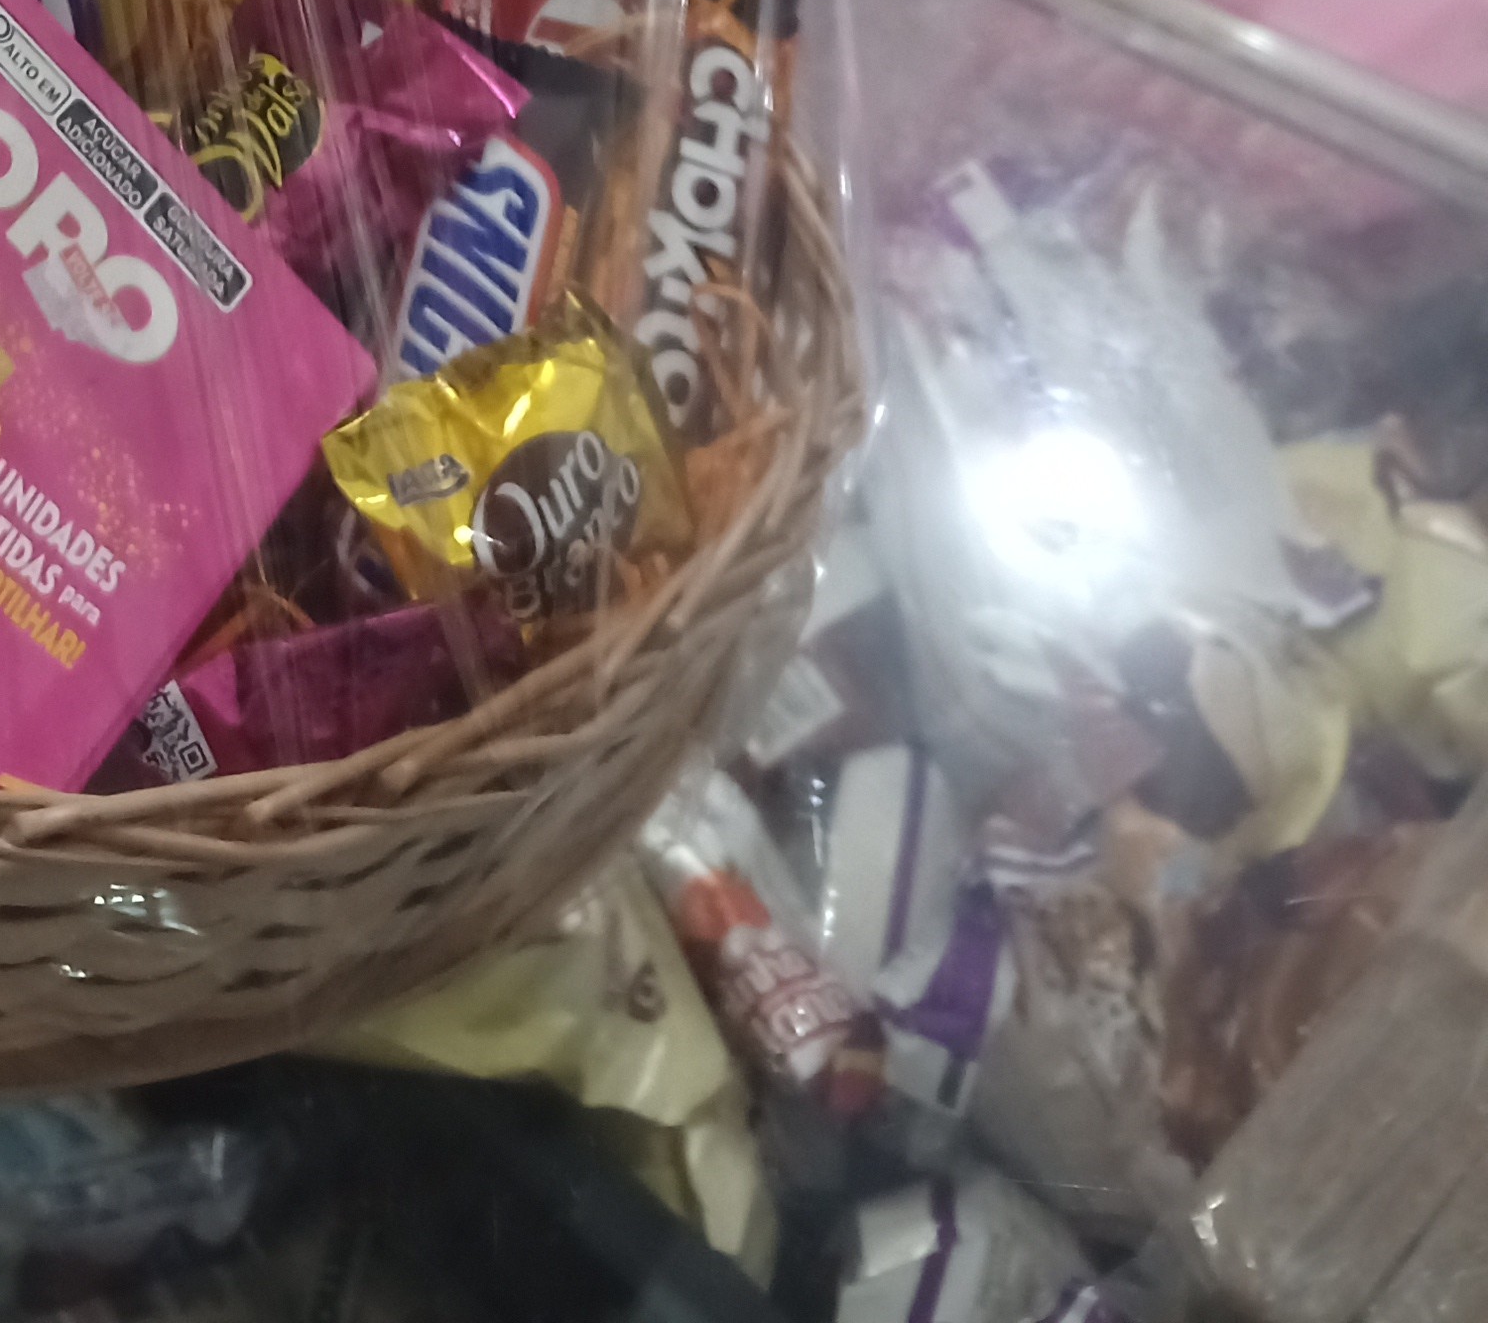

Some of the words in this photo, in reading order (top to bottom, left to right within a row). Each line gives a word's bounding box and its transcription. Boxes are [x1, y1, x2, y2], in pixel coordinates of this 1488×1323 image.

[2, 43, 40, 80] ALTO
[37, 77, 61, 104] EM
[59, 116, 142, 207] ADICIONADO
[472, 430, 604, 577] Ouro
[58, 584, 101, 628] para
